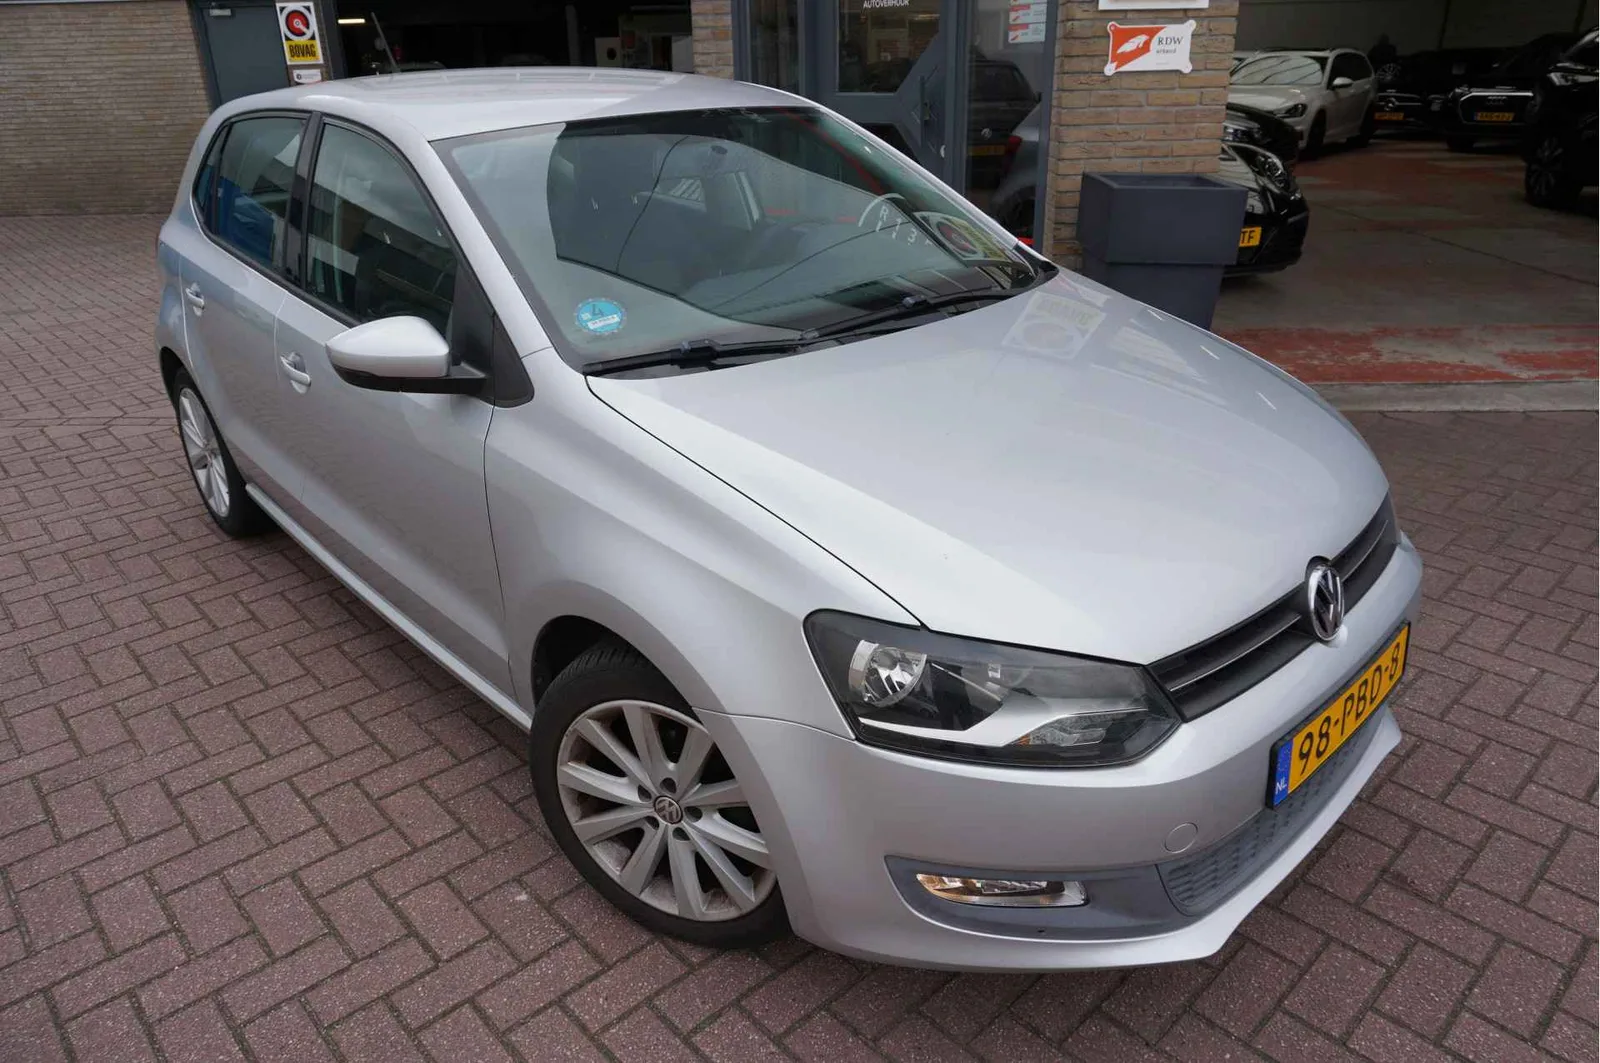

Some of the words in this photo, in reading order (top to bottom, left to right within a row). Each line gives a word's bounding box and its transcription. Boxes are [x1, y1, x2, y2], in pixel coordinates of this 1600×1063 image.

[1158, 36, 1183, 45] RDW
[289, 44, 317, 57] BOVAG
[1298, 642, 1400, 775] 98-PBD-8
[1275, 777, 1287, 795] NL
